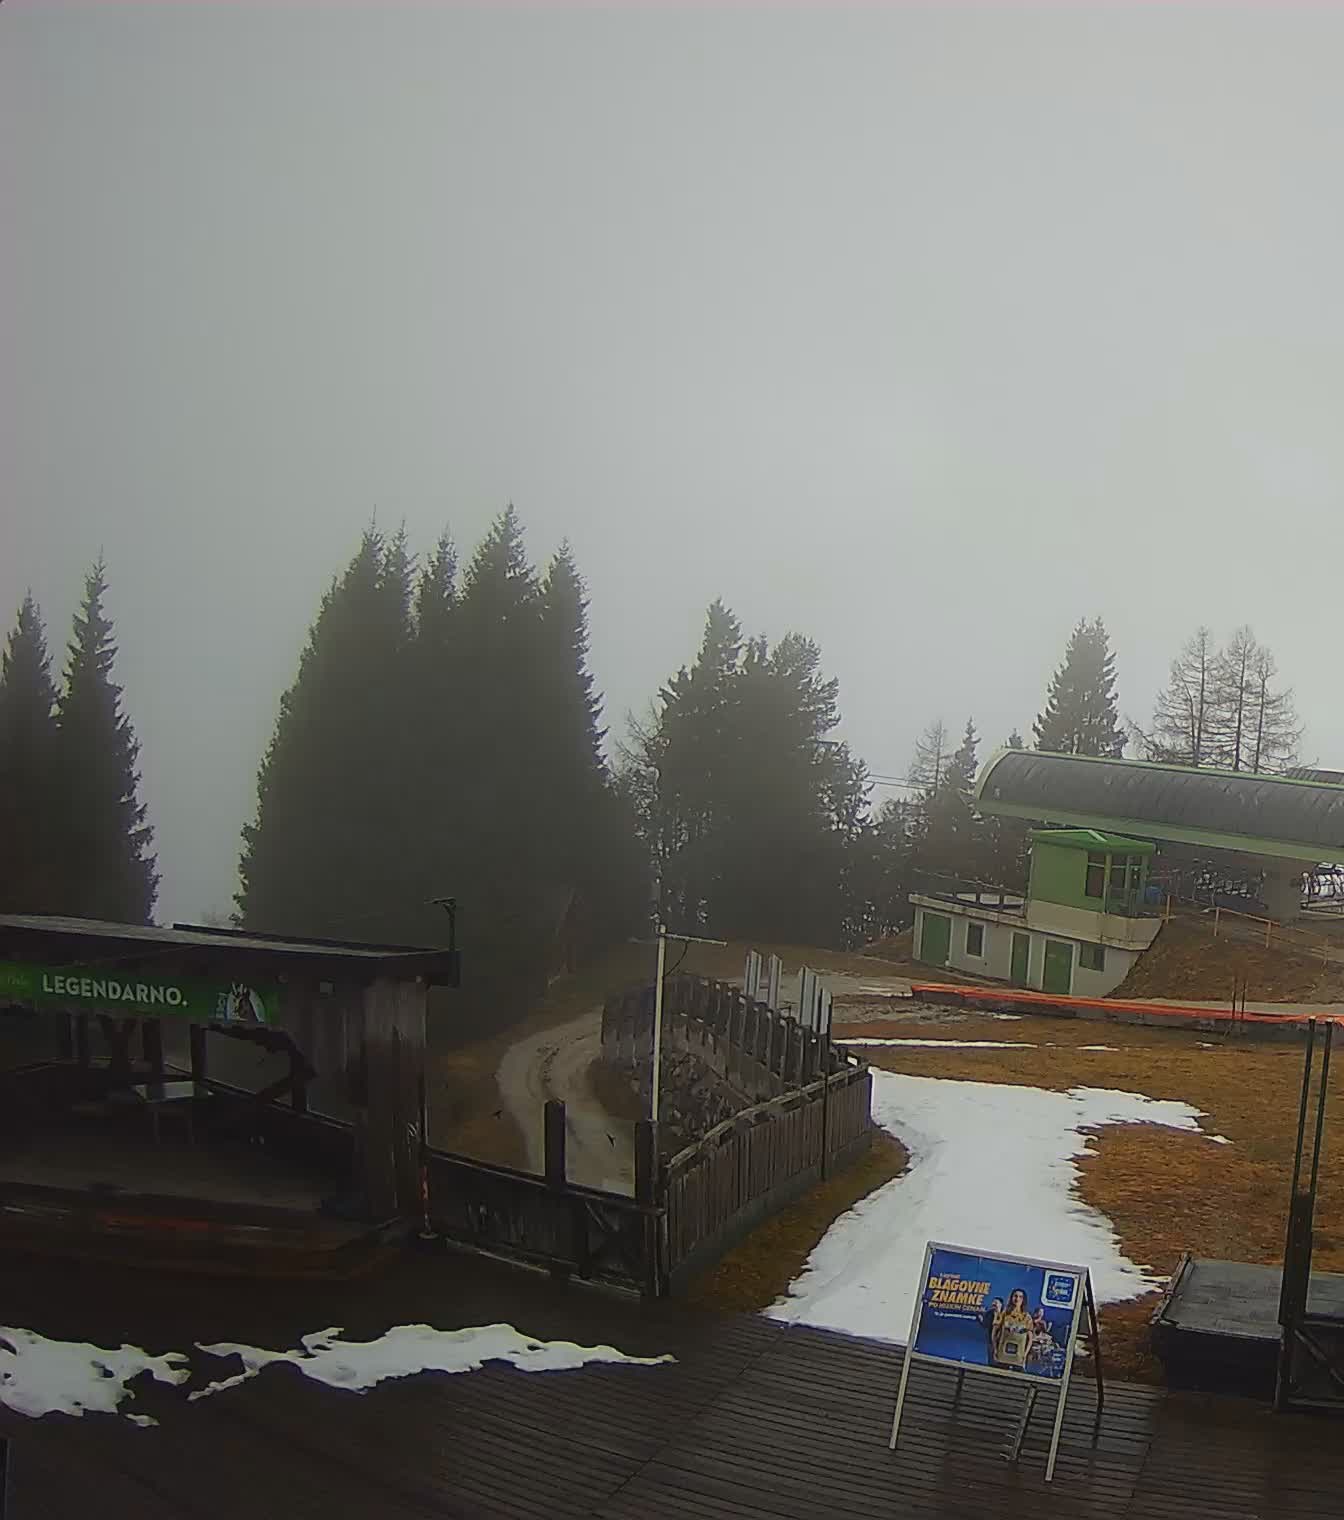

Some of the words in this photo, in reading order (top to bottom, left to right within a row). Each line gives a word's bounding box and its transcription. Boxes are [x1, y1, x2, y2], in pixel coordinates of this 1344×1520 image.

[42, 974, 189, 1006] LEGENDARNO.
[928, 1276, 991, 1295] BLAGOVNE
[931, 1289, 985, 1305] ZNAMKE
